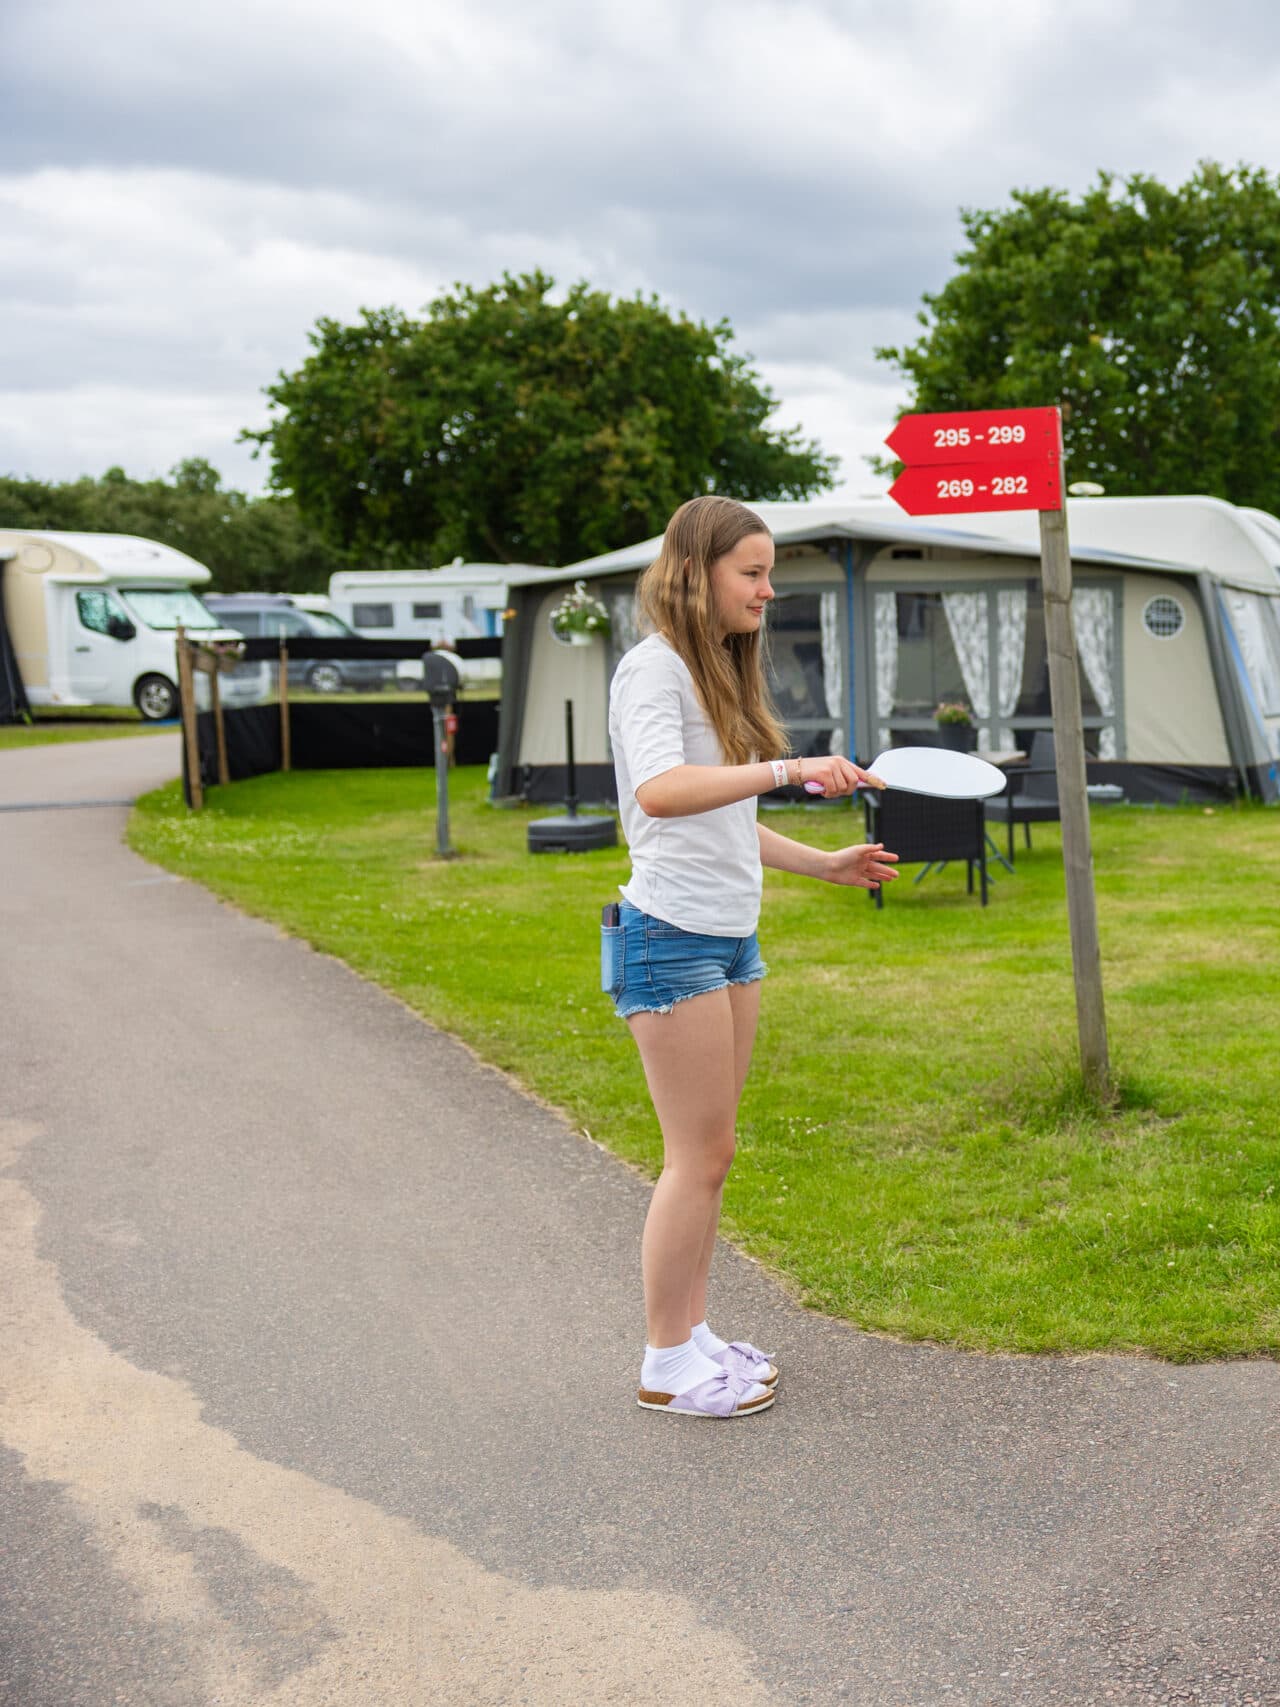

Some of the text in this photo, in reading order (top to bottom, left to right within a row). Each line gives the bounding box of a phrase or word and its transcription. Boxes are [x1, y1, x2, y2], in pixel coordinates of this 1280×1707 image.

[934, 428, 971, 447] 295
[987, 425, 1026, 444] 299
[936, 479, 974, 498] 269
[991, 476, 1028, 495] 282
